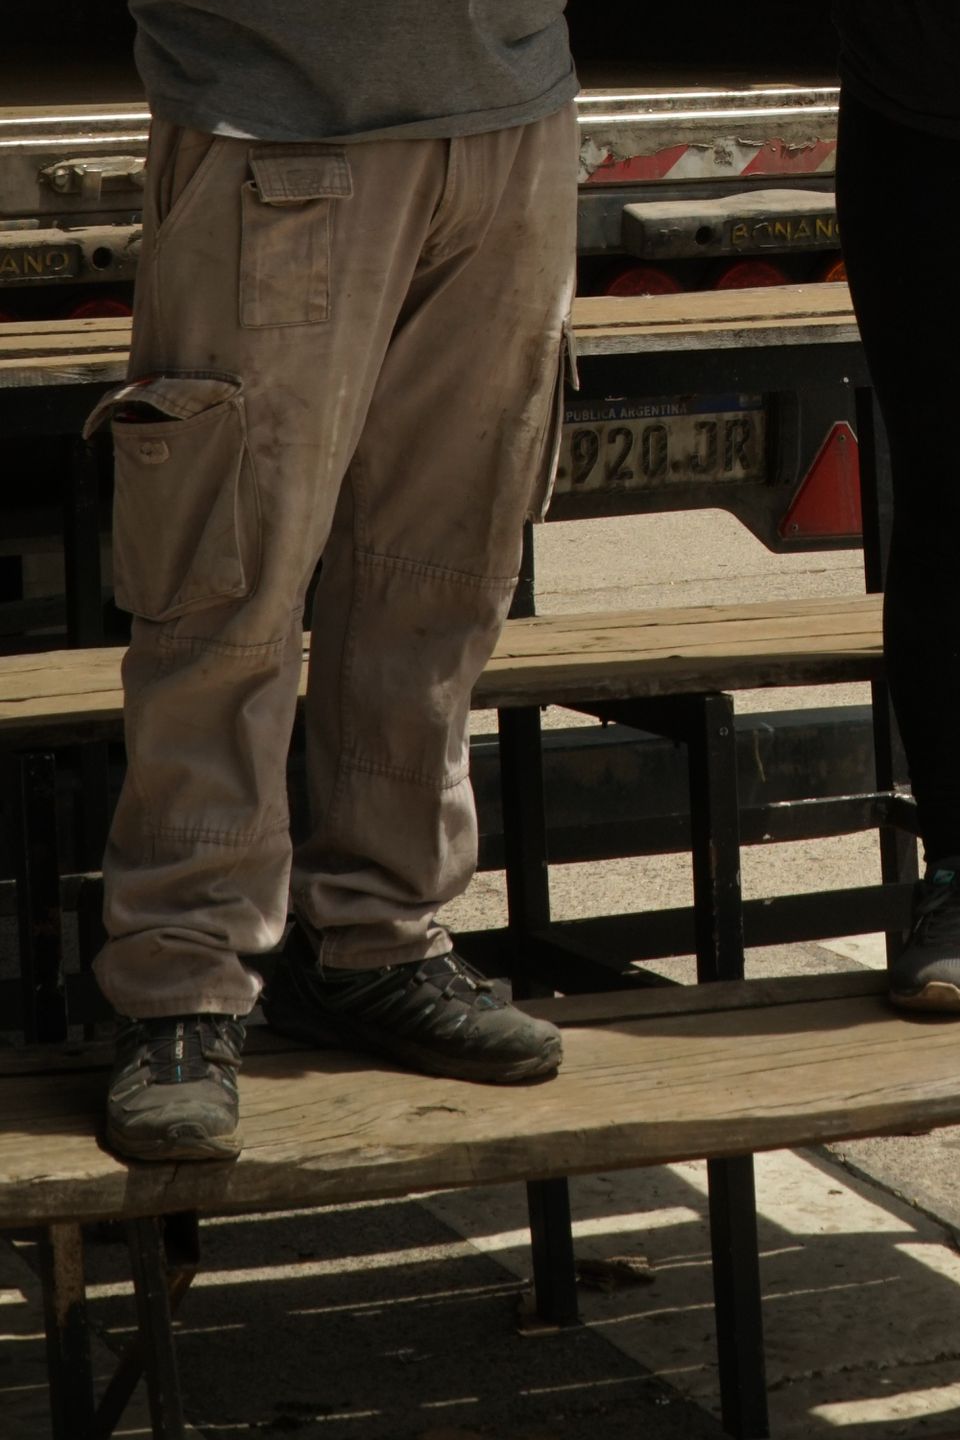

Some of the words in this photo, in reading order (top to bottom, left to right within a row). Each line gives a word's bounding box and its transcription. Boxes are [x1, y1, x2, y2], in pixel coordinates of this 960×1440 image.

[731, 217, 841, 246] BONAN
[565, 407, 617, 423] PUBLICA
[619, 403, 688, 420] ARGENTINA
